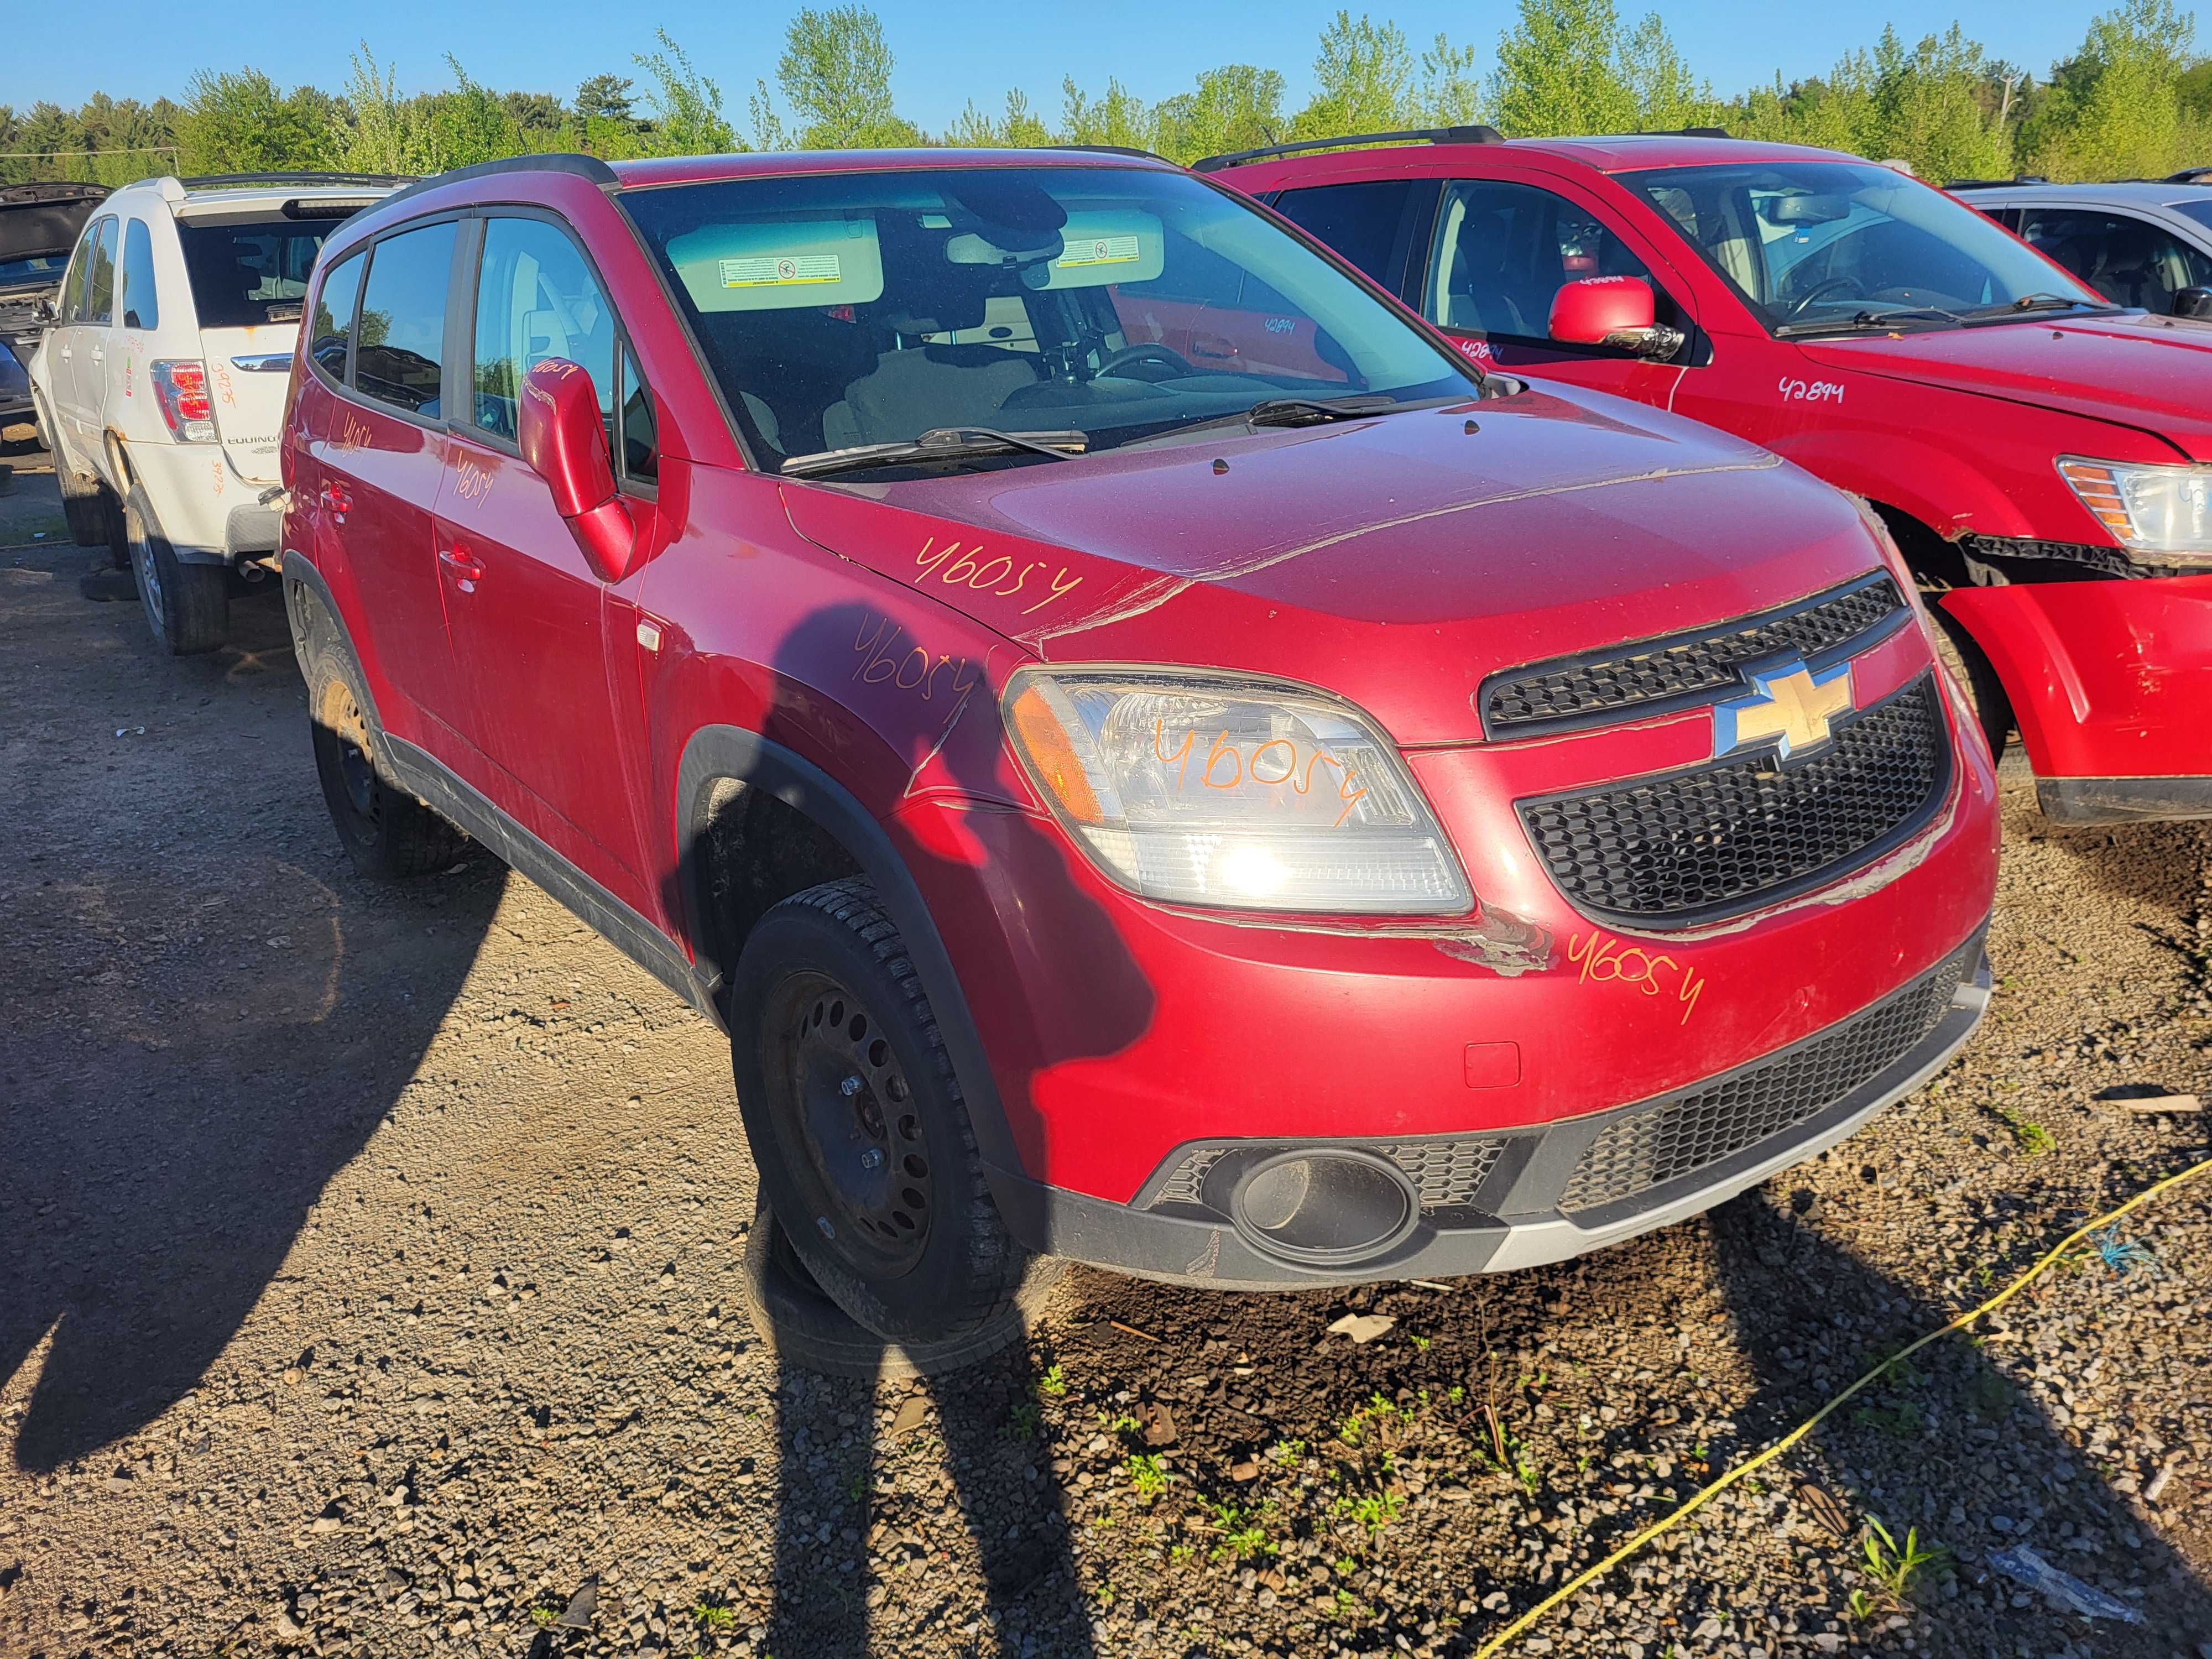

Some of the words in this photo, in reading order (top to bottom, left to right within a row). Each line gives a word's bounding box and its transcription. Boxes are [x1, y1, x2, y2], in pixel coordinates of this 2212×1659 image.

[1264, 318, 1295, 336] 42894
[211, 363, 237, 409] 39275
[1778, 376, 1845, 404] 42894
[453, 450, 494, 509] 46054
[914, 536, 1084, 615] 46054
[852, 613, 974, 724] 46054
[1154, 719, 1367, 828] 46054
[1567, 930, 1705, 1026] 46054
